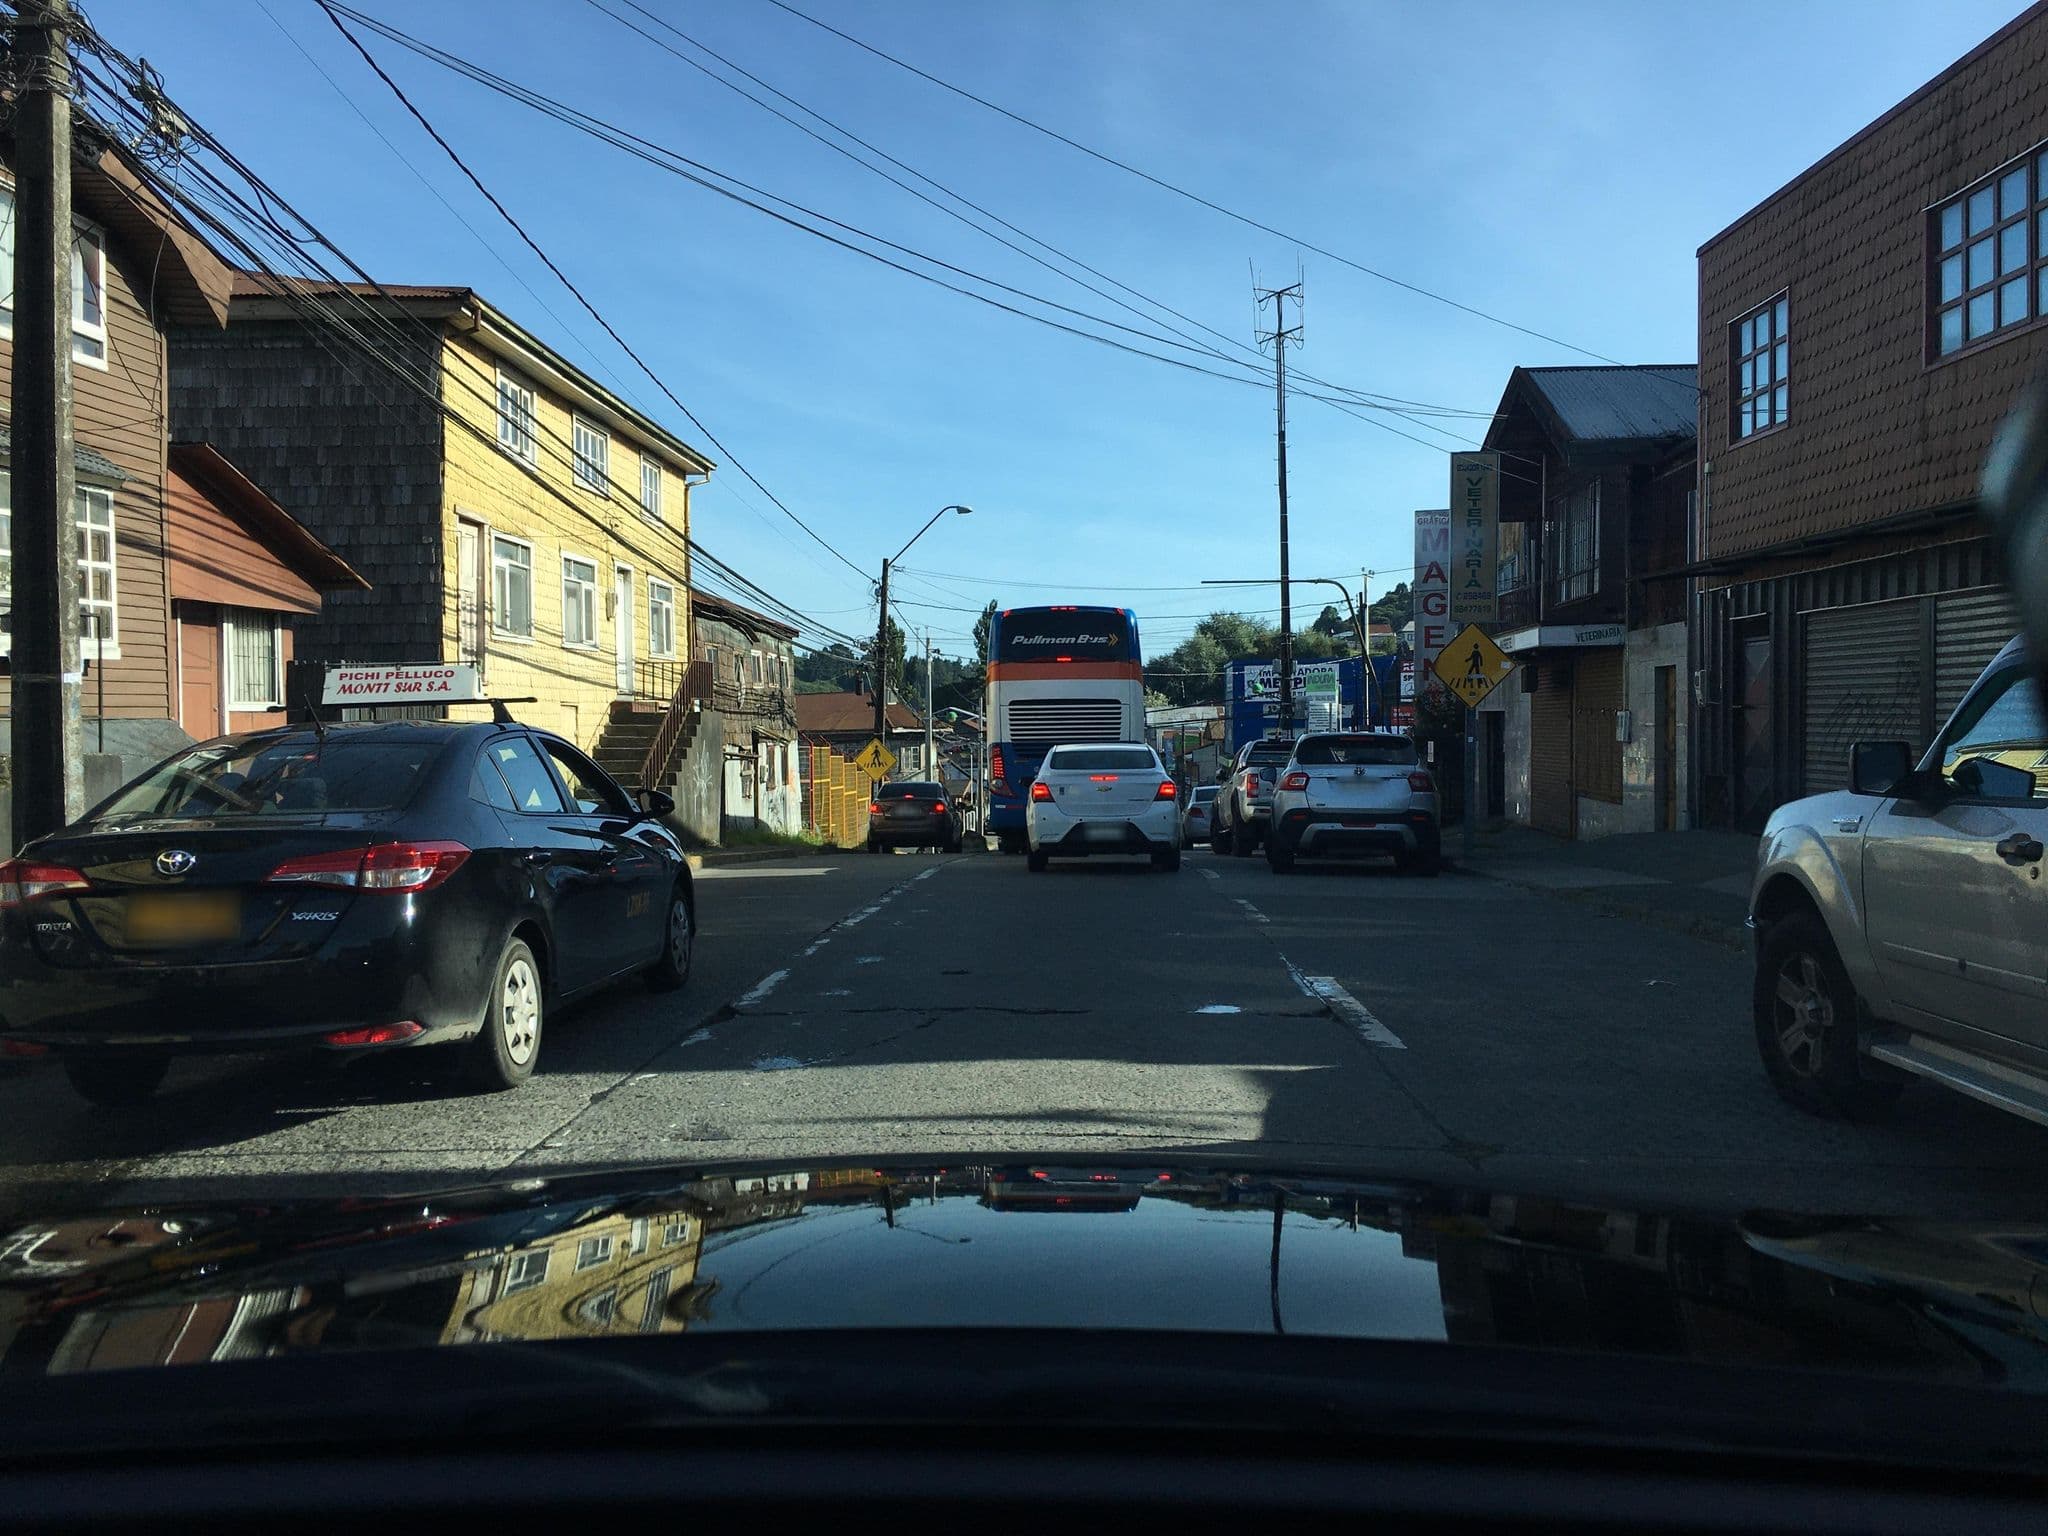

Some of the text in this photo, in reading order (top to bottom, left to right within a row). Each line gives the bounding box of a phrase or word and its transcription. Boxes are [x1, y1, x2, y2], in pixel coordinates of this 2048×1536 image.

[1466, 477, 1482, 588] VETERINARIA
[1012, 634, 1108, 645] Pullman Bus
[1575, 627, 1623, 643] VETERINARIA
[339, 670, 455, 681] PICHI PELLUCO
[337, 681, 452, 695] MONTT SUR S.A.
[292, 911, 339, 921] YARIS
[35, 921, 72, 931] TOYOTA
